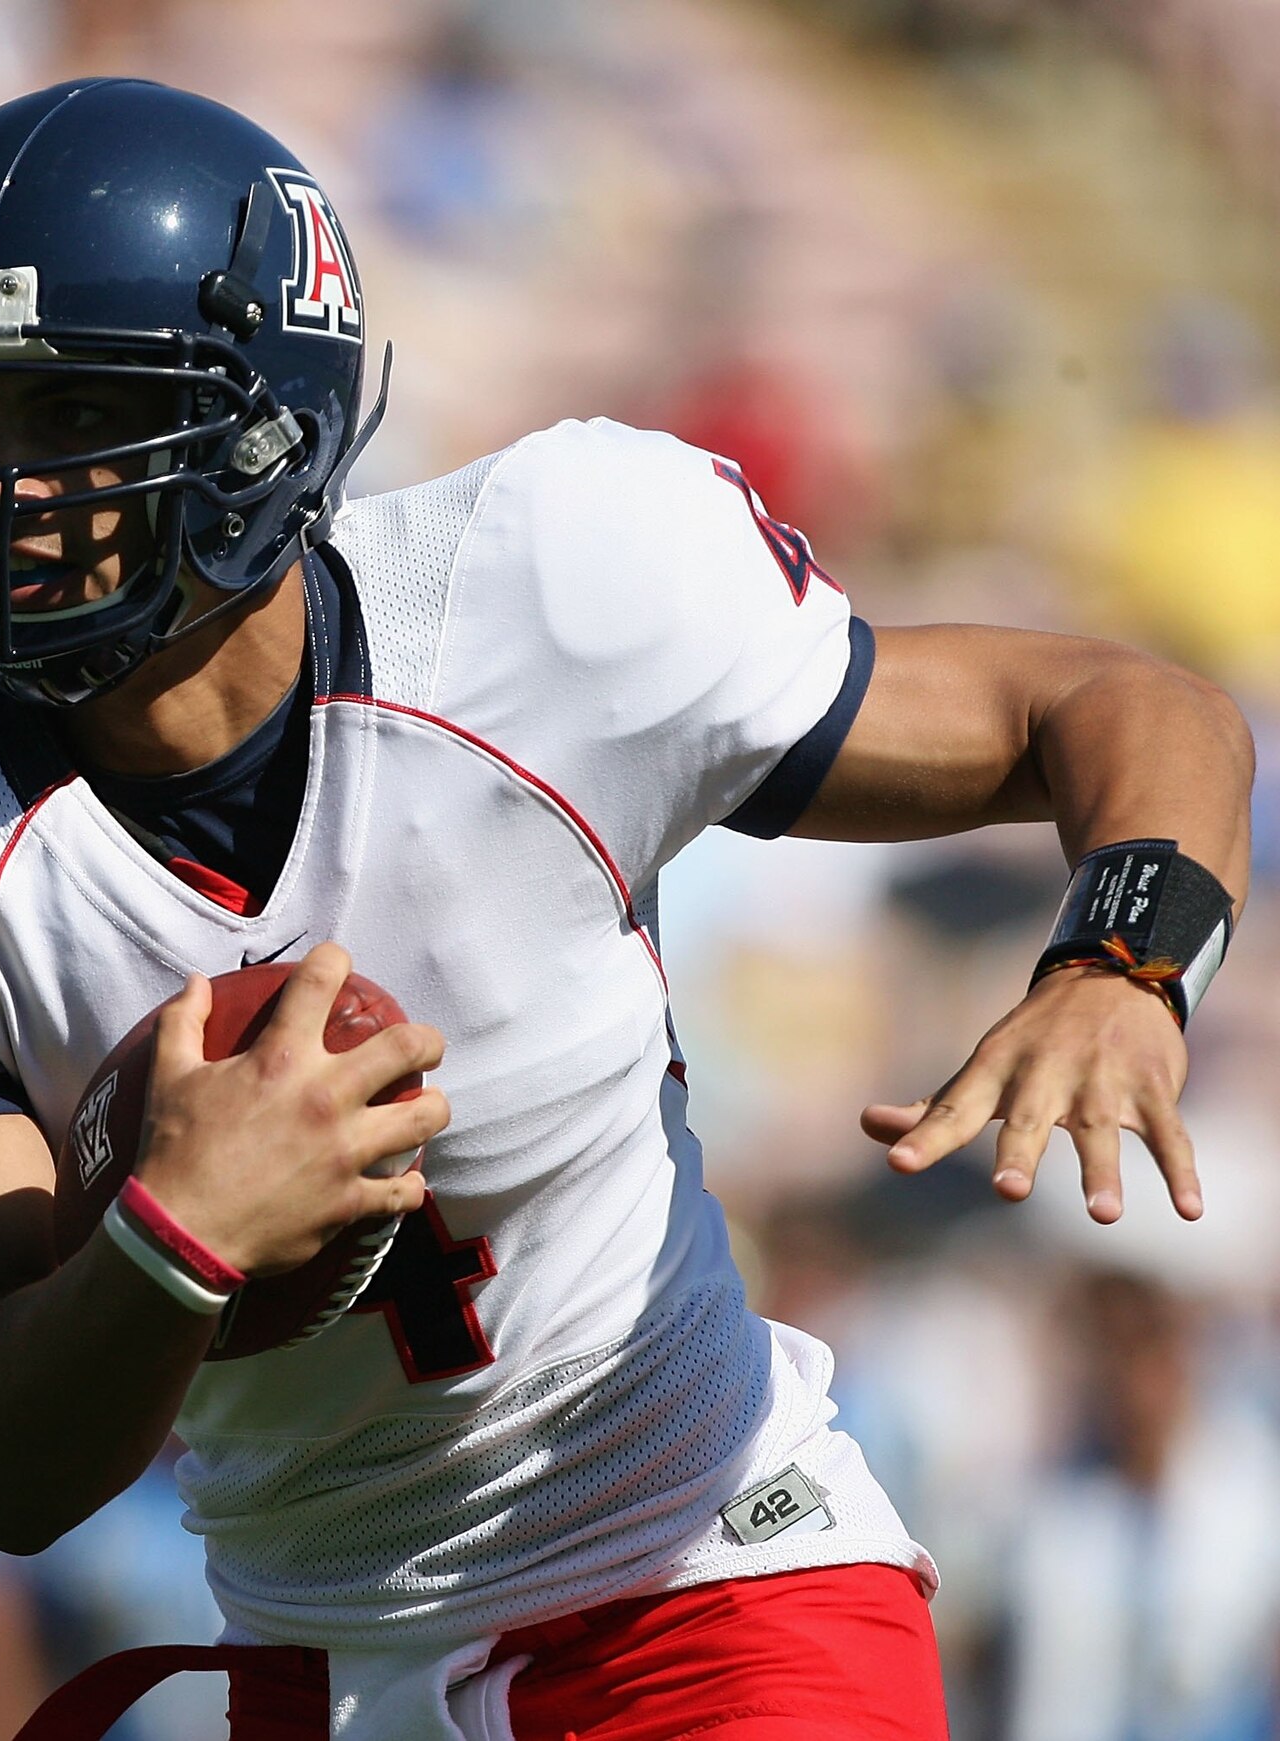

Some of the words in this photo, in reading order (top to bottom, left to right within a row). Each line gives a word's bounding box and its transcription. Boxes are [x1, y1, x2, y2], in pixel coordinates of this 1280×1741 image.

[266, 167, 363, 345] A
[1137, 864, 1159, 892] Wrist
[1128, 896, 1149, 923] Plan
[749, 1488, 800, 1528] 42
